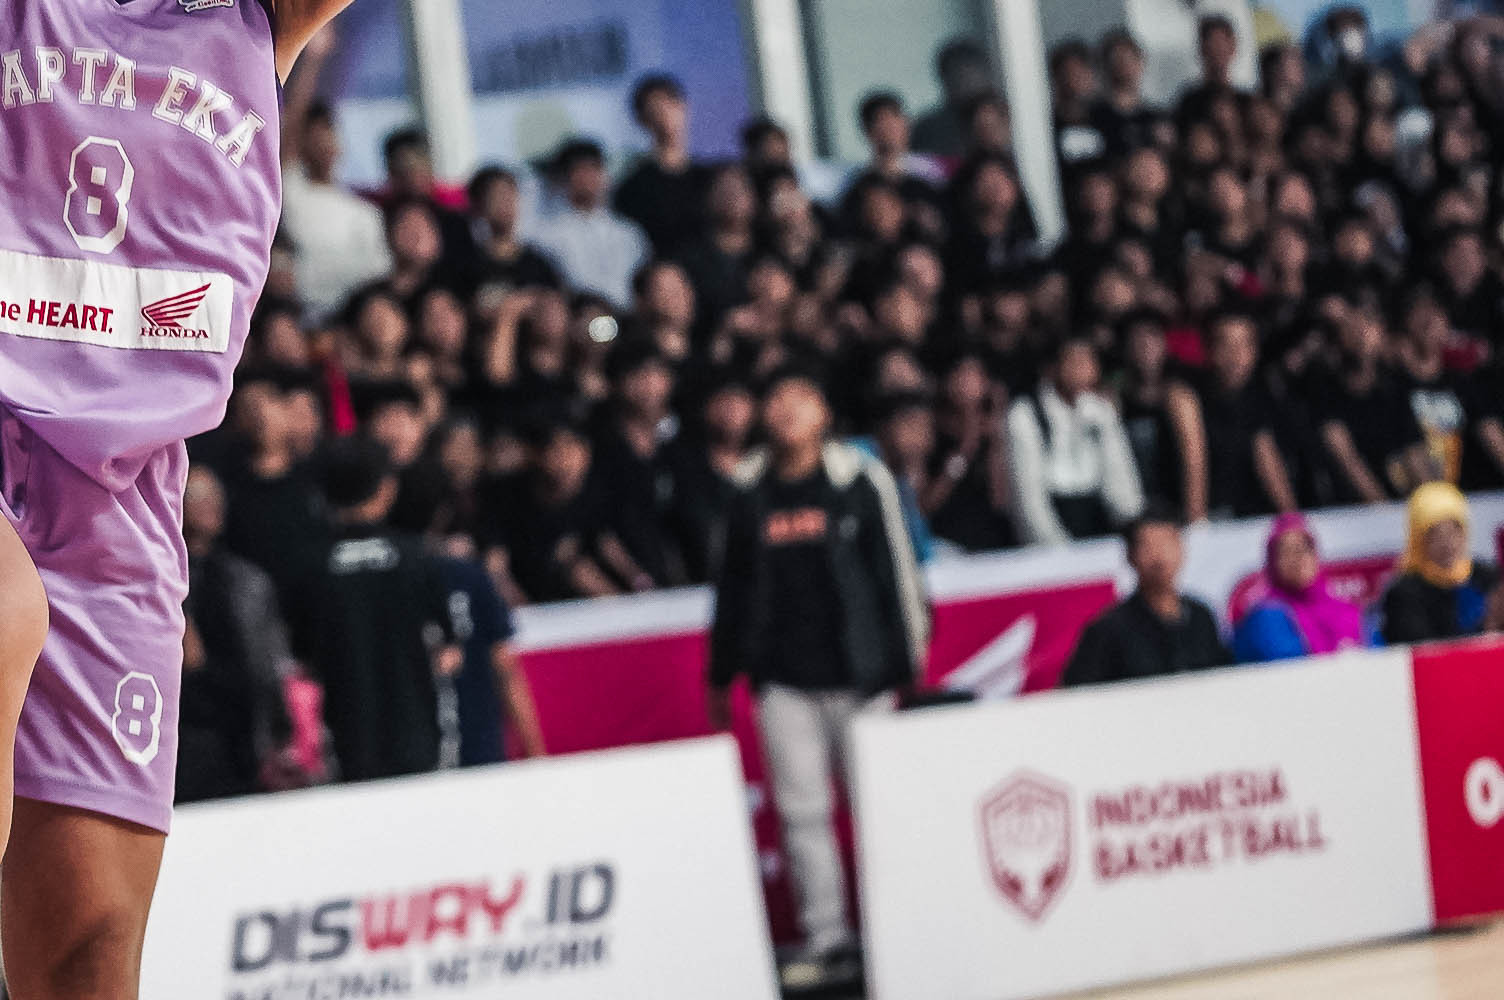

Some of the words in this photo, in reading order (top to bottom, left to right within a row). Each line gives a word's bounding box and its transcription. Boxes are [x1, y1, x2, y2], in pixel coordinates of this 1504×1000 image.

[152, 66, 267, 169] EKA
[63, 135, 135, 255] 8
[27, 297, 114, 335] HEART.
[140, 326, 209, 339] HONDA
[112, 671, 163, 766] 8
[1089, 767, 1288, 828] INDONESIA
[1096, 810, 1328, 881] BASKETBALL
[428, 937, 608, 986] NETWORK
